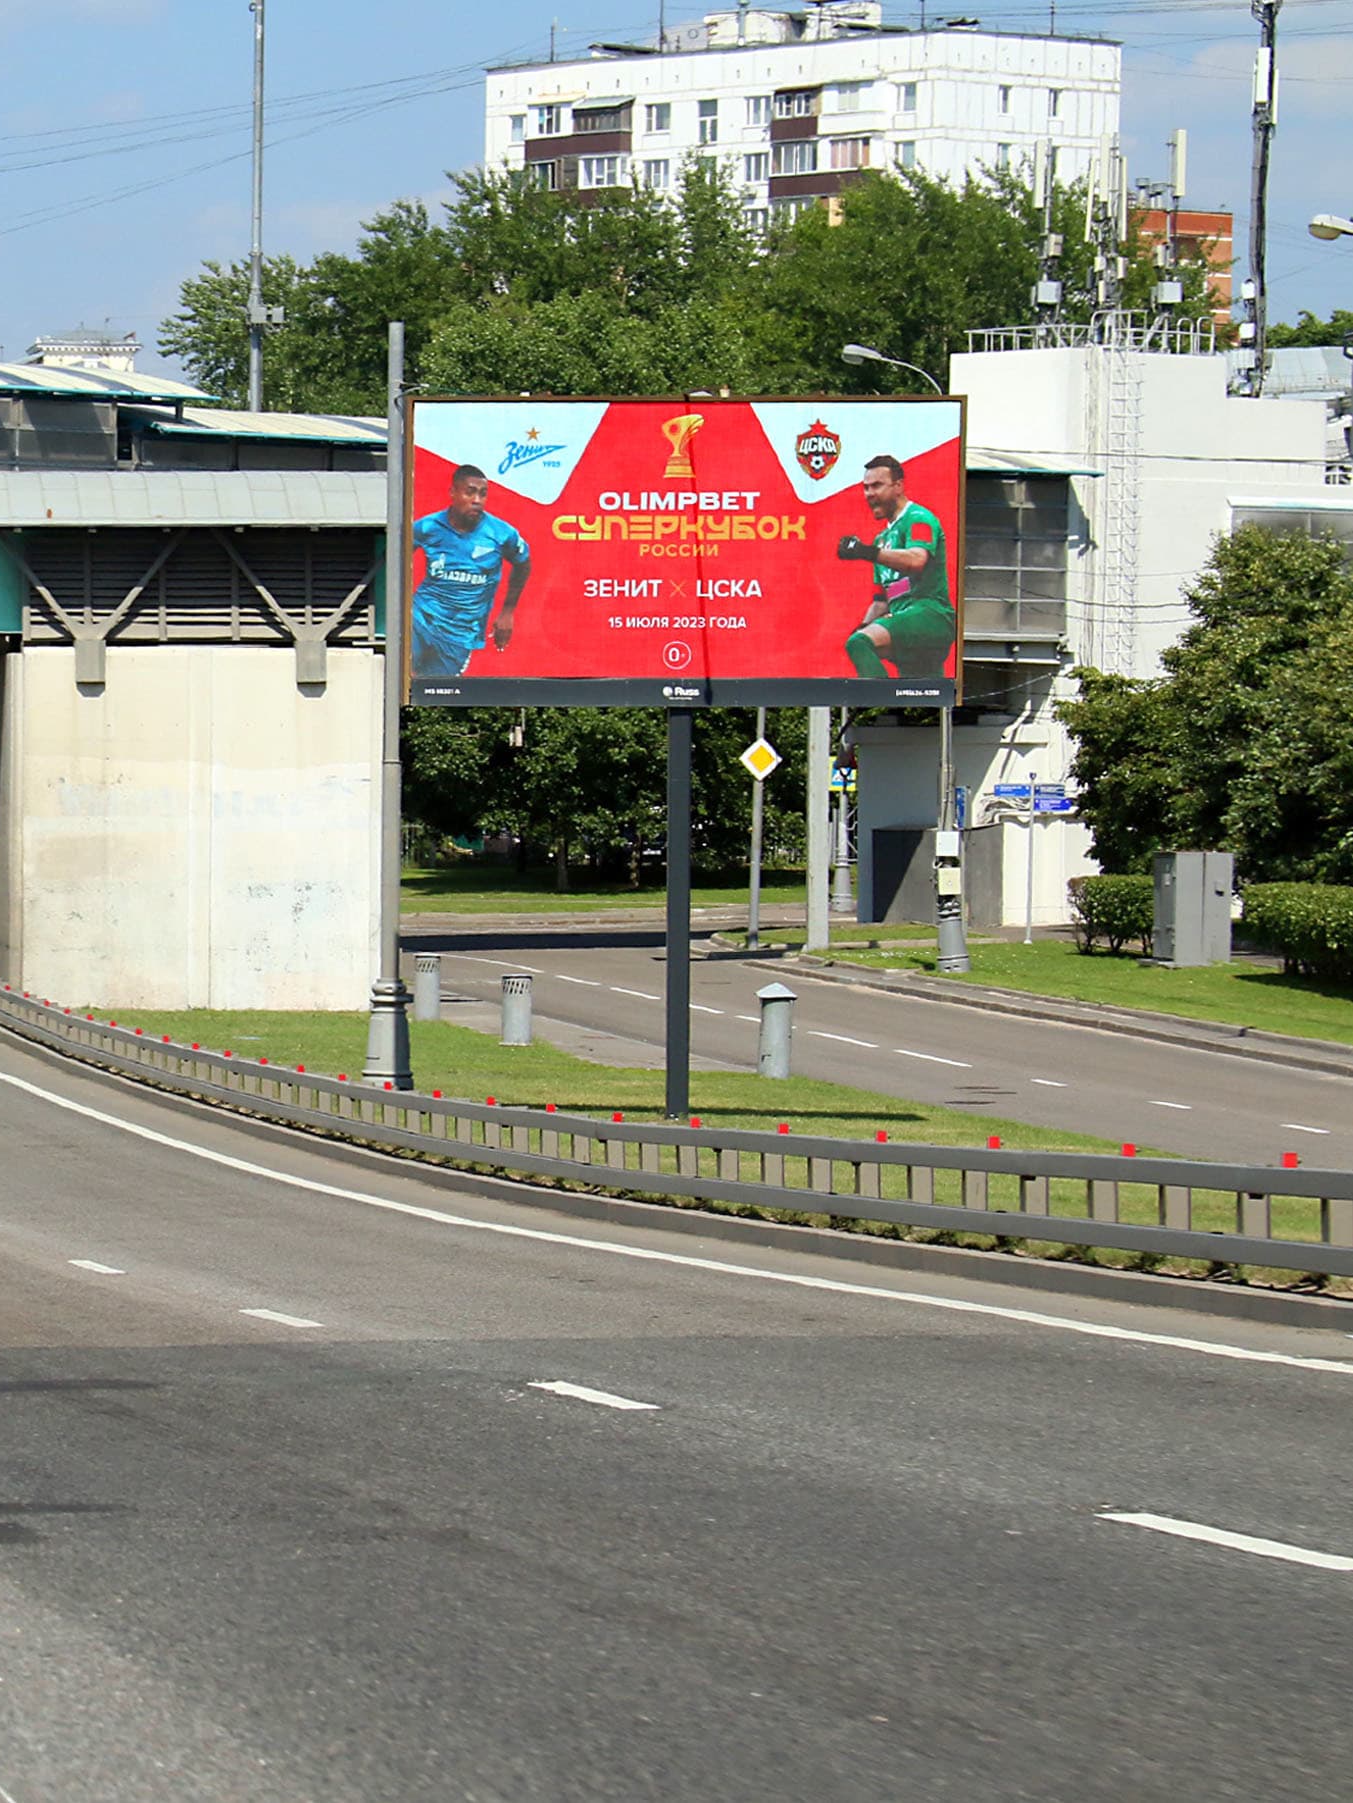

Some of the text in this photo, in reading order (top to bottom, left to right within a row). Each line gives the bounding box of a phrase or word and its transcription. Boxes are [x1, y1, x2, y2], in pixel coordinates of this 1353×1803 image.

[800, 436, 837, 454] ЦСКА
[598, 491, 761, 511] OLIMPBET
[551, 515, 807, 540] СУПЕРКУБОК
[639, 543, 719, 557] РОССИИ
[583, 578, 763, 600] ЗЕНИТ ЦСКА
[608, 616, 747, 629] 15 ИЮЛЯ 2023 ГОДА
[674, 686, 700, 697] Russ
